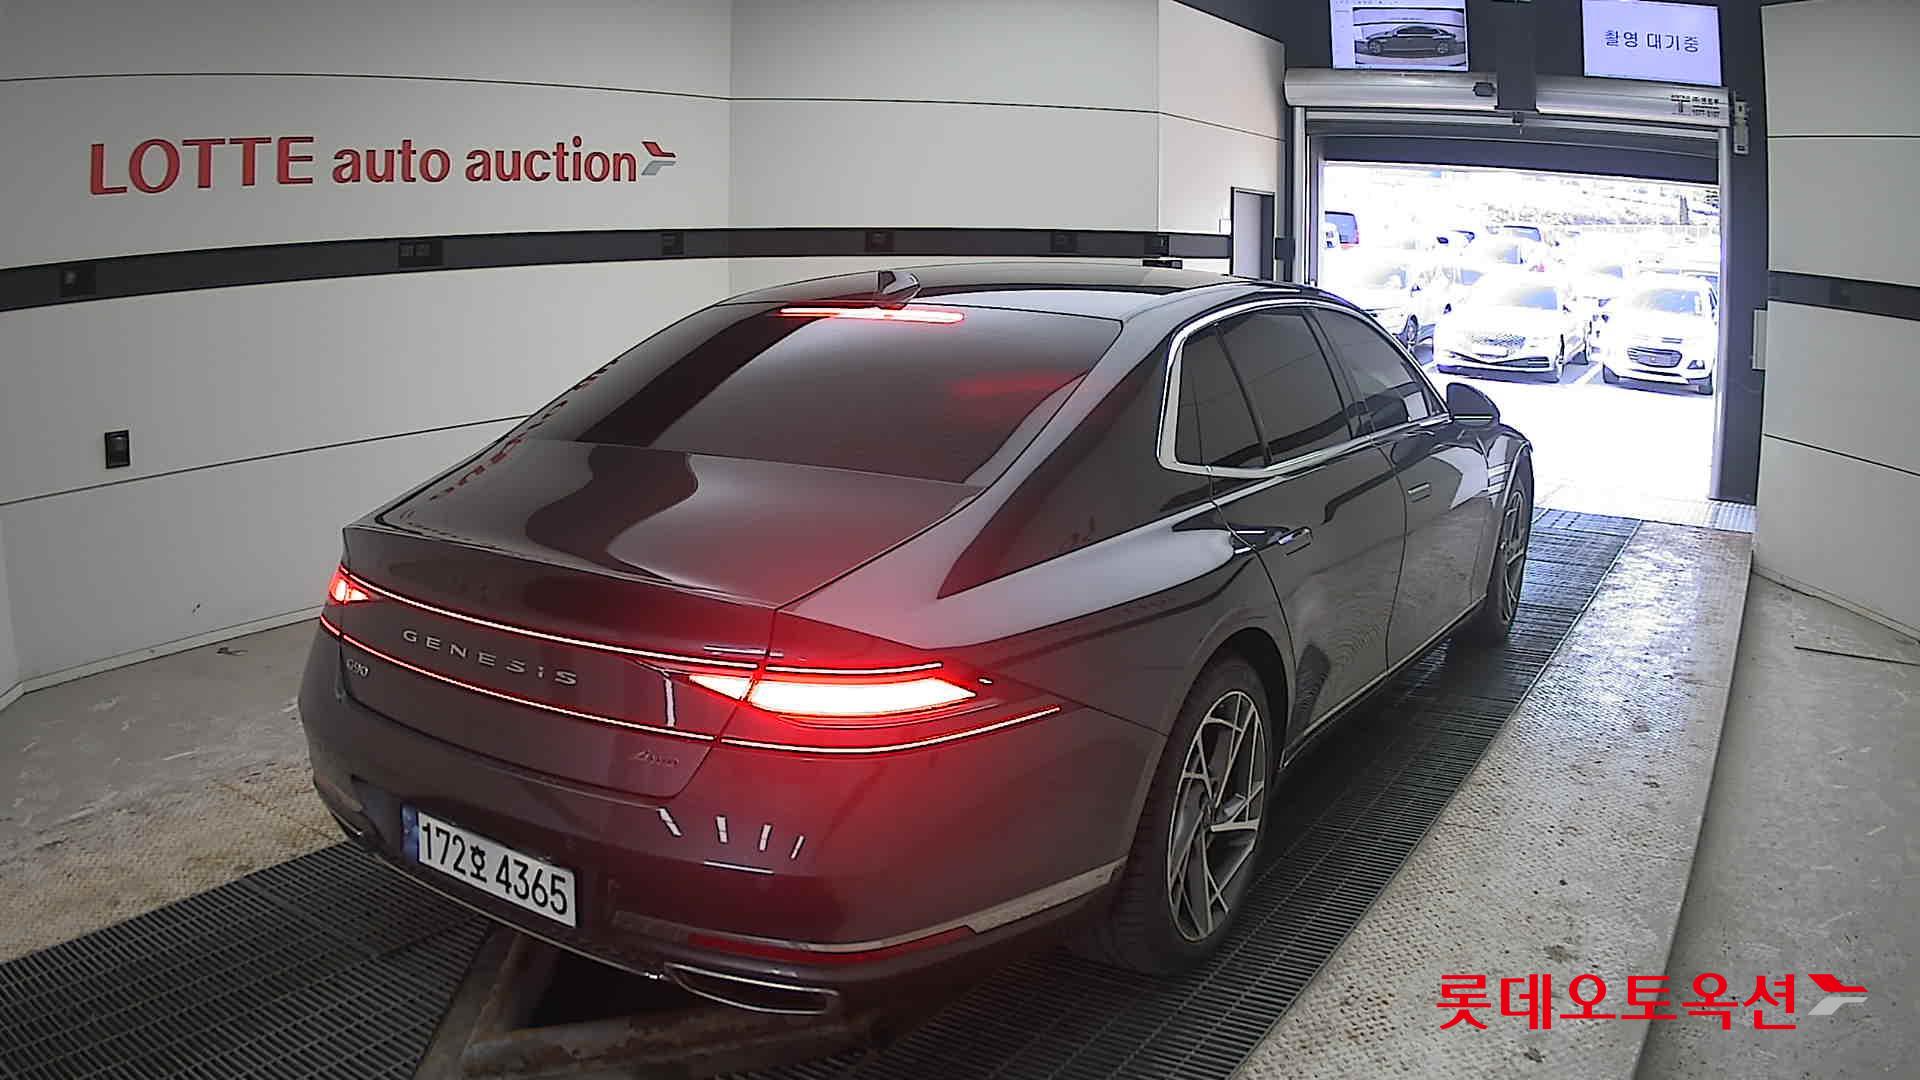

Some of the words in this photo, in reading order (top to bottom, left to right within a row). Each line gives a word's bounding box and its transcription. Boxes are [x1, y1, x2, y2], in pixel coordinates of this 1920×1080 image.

[1605, 30, 1639, 49] 촬영
[1646, 32, 1699, 53] 대기중
[90, 136, 314, 196] LOTTE
[332, 139, 451, 184] auto
[464, 135, 638, 184] auction
[402, 629, 578, 687] GENESIS
[495, 854, 568, 916] 4365
